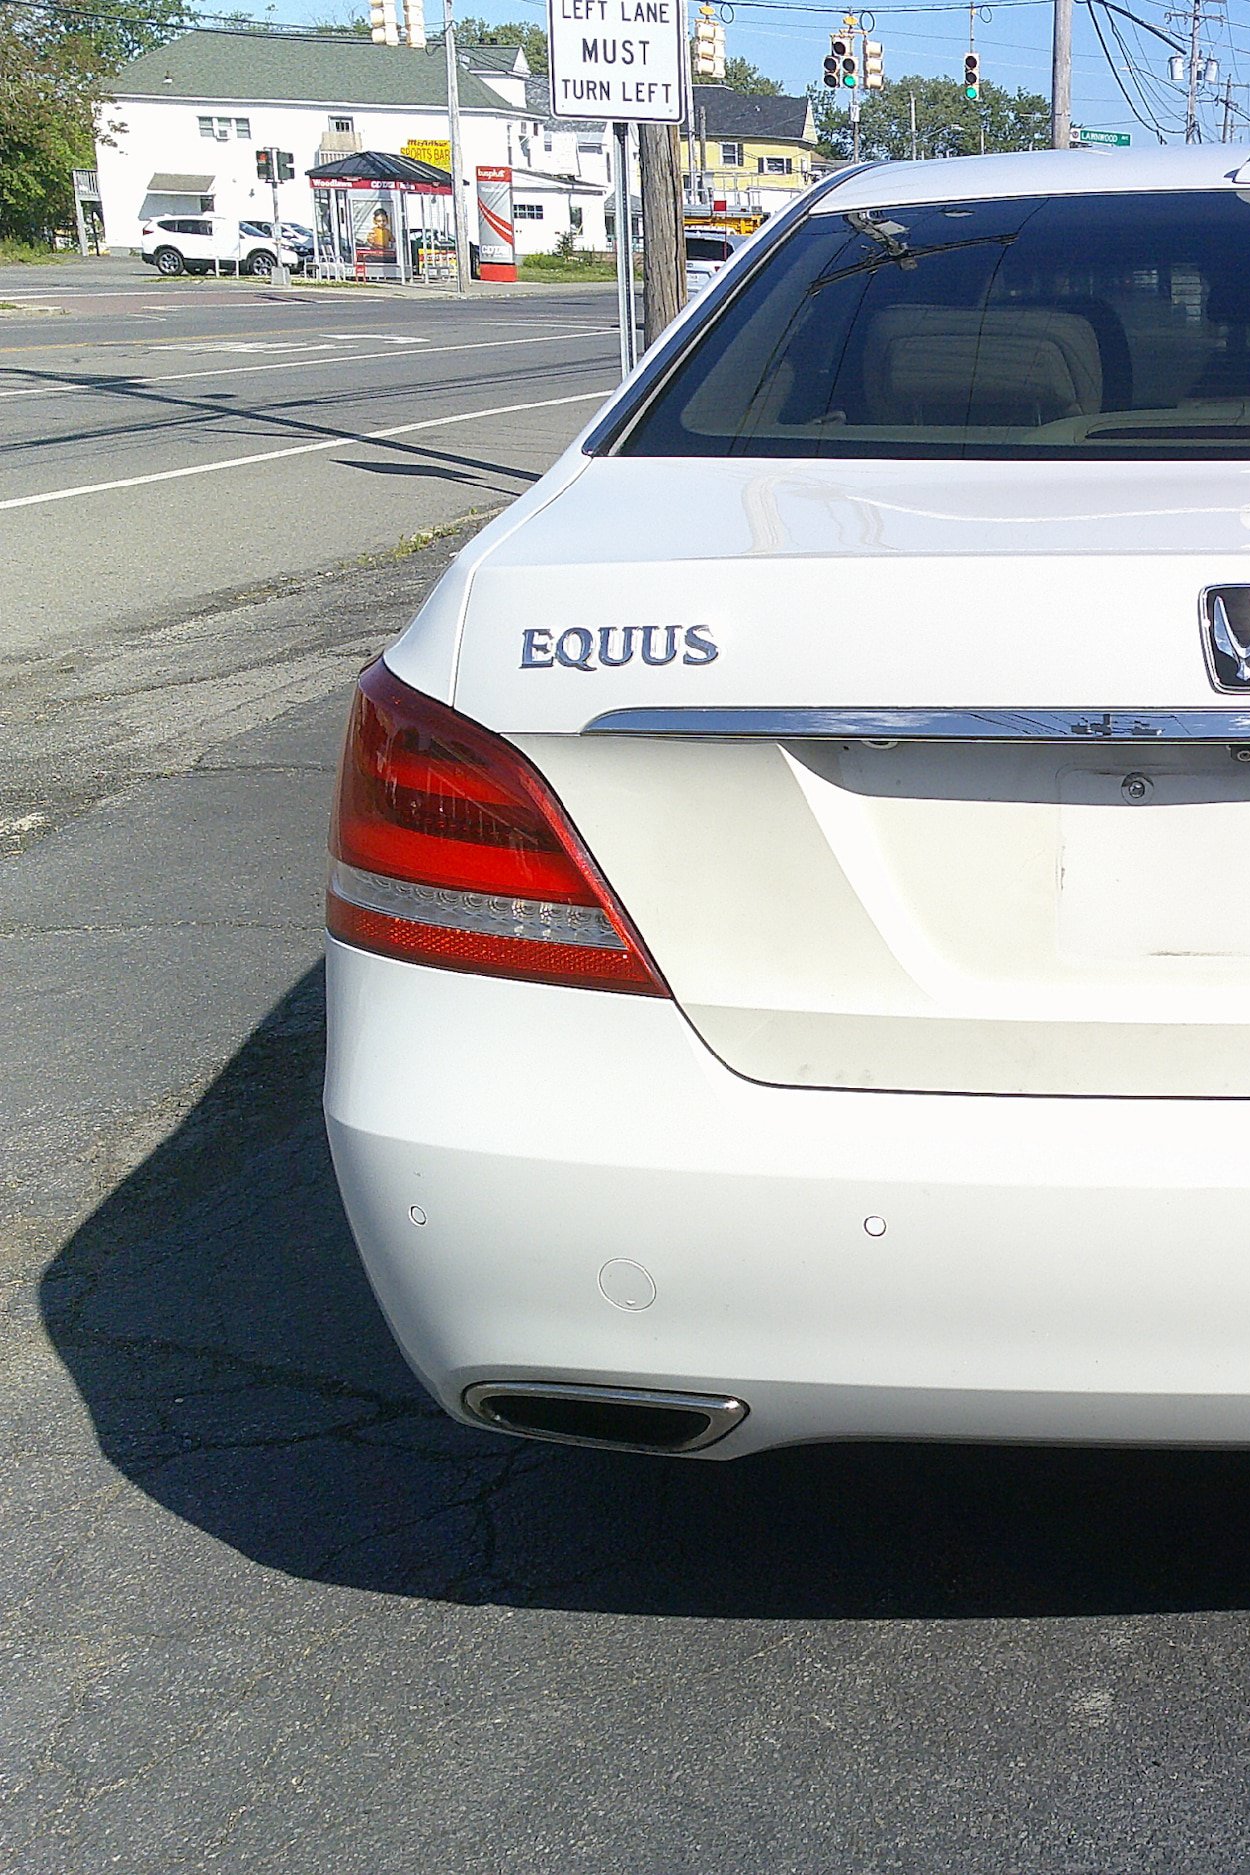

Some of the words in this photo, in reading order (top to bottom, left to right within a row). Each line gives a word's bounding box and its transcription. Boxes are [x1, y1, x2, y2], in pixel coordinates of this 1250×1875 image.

[562, 0, 608, 20] LEFT
[621, 1, 670, 23] LANE
[582, 38, 650, 65] MUST
[562, 79, 611, 100] TURN
[622, 82, 672, 103] LEFT
[400, 147, 433, 160] SPORTS
[434, 148, 450, 161] BAR
[312, 178, 353, 188] Woodlawn
[518, 624, 720, 672] EQUUS
